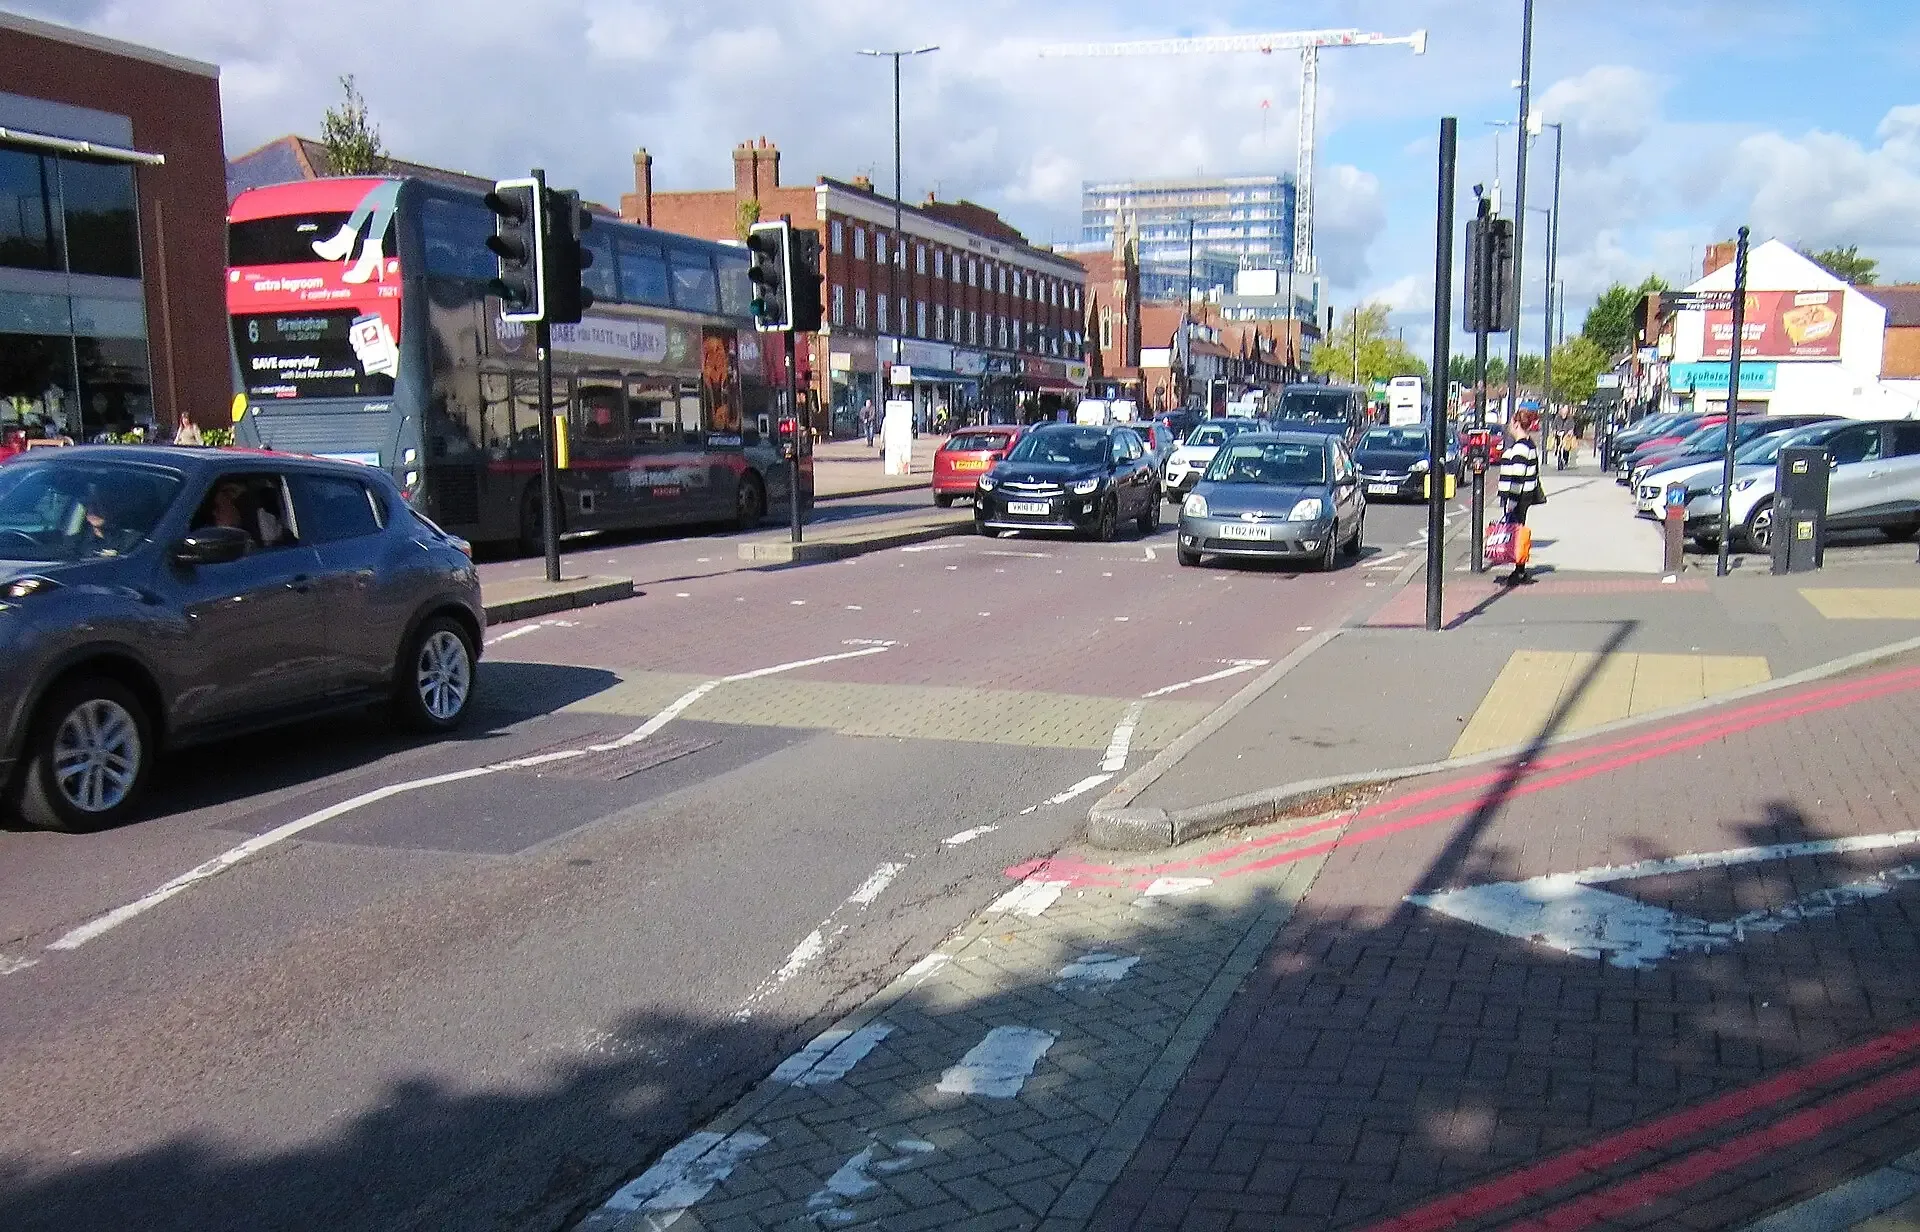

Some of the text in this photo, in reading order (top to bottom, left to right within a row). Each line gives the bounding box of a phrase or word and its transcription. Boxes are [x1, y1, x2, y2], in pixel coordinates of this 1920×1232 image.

[253, 277, 324, 292] extra legroom
[248, 319, 260, 343] 6
[252, 355, 320, 370] SAVE everyday
[324, 370, 333, 378] on
[333, 367, 356, 378] mobile
[1248, 526, 1267, 537] RYN
